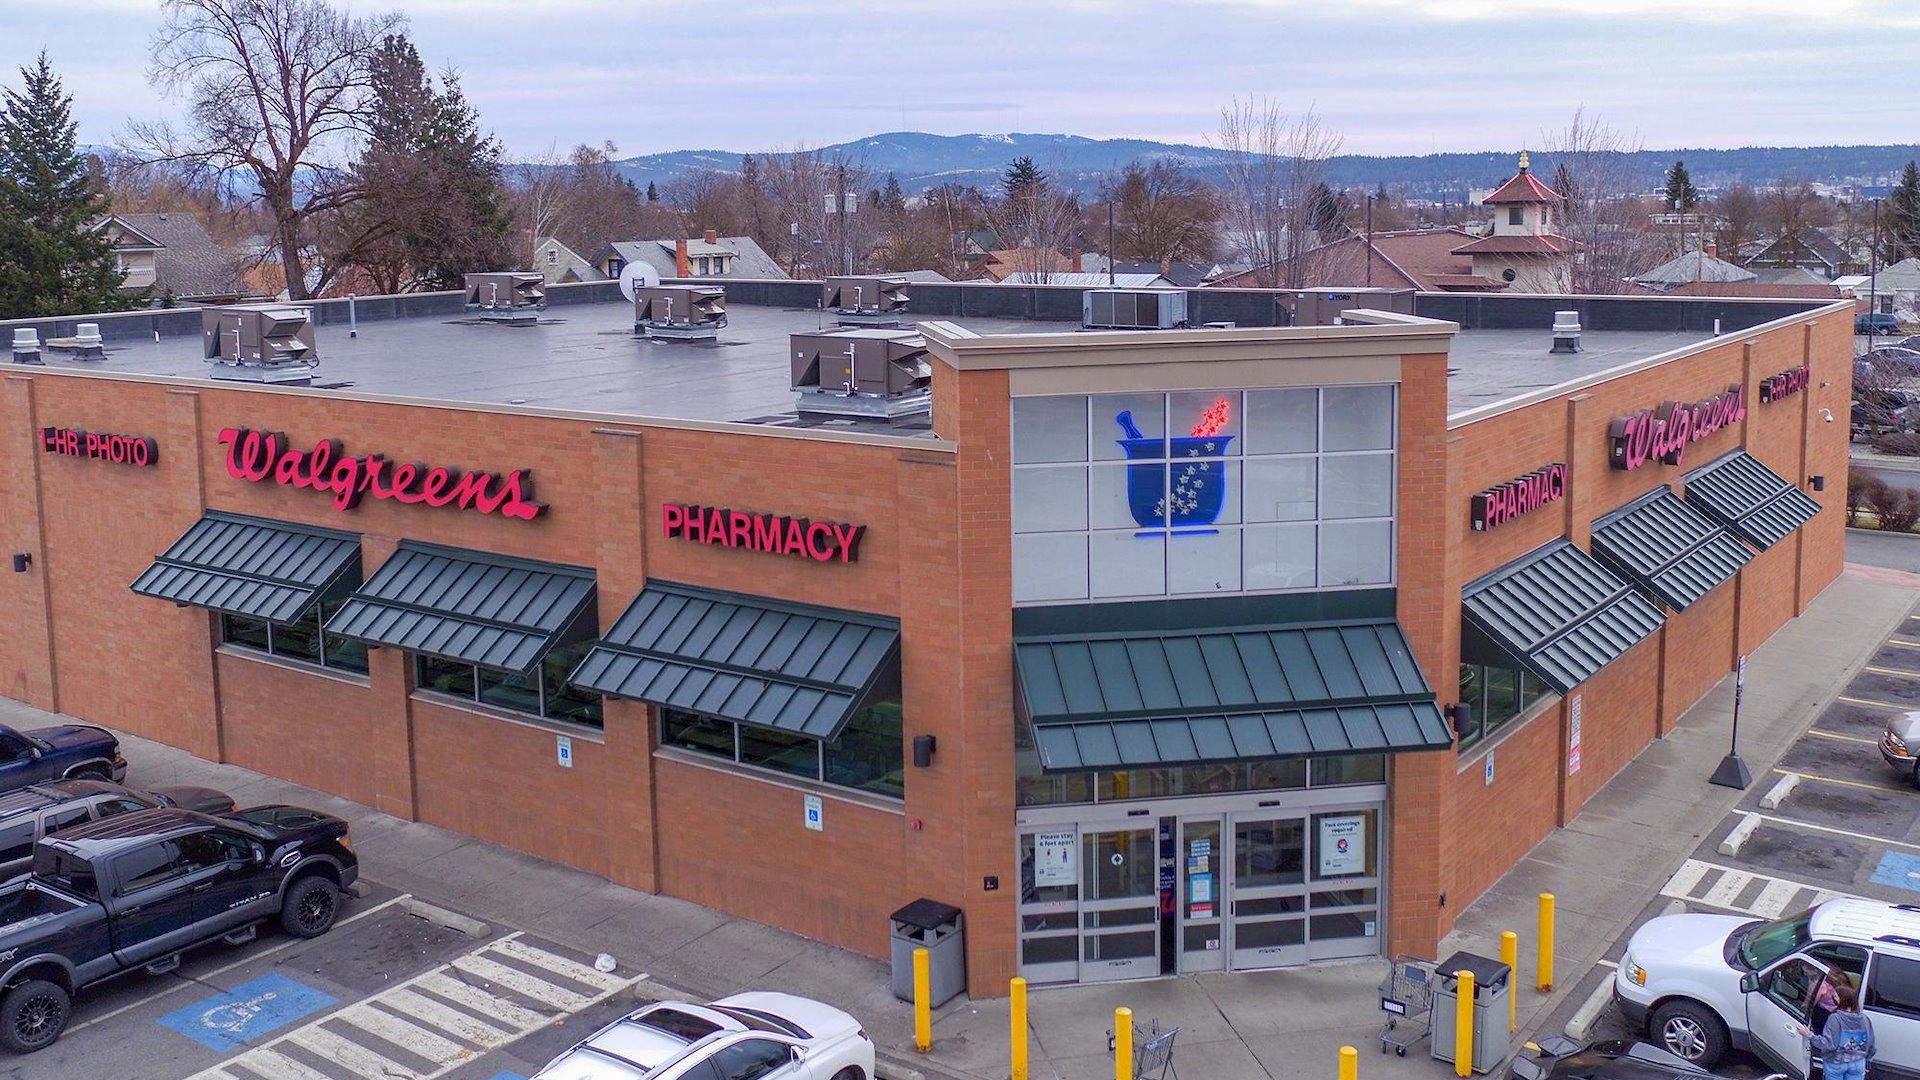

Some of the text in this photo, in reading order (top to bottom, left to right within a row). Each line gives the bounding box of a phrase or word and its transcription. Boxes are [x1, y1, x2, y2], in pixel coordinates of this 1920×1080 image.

[1788, 365, 1809, 394] PHOTO
[40, 427, 148, 465] 1-HR PHOTO
[1624, 384, 1746, 470] Walgreens
[218, 428, 540, 520] Walgreens
[1485, 464, 1568, 532] PHARMACY
[662, 503, 858, 564] PHARMACY
